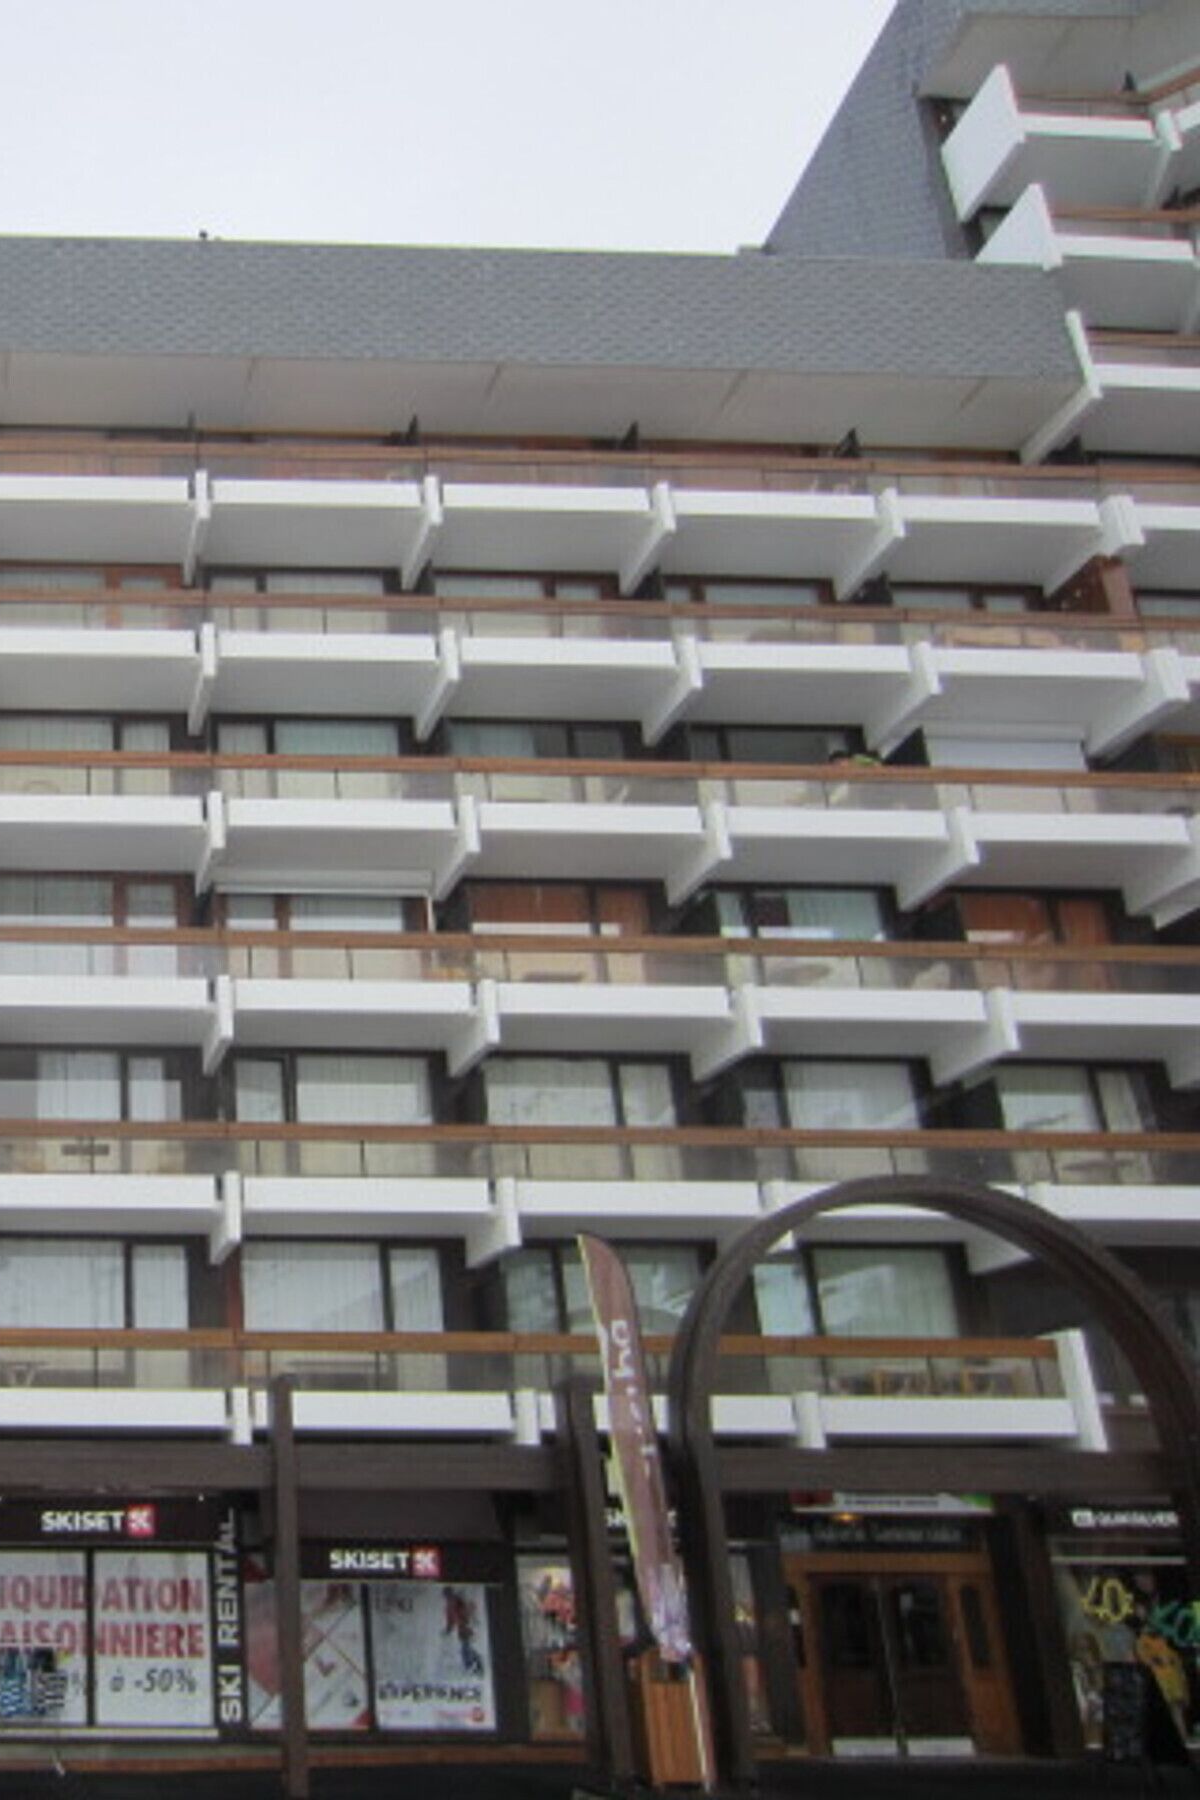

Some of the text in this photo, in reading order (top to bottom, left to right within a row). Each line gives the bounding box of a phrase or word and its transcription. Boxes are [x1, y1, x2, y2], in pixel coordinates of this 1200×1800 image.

[41, 1510, 125, 1532] SKISET
[329, 1549, 410, 1570] SKISET
[213, 1506, 243, 1723] SKI RENTAL
[134, 1667, 197, 1694] -50%
